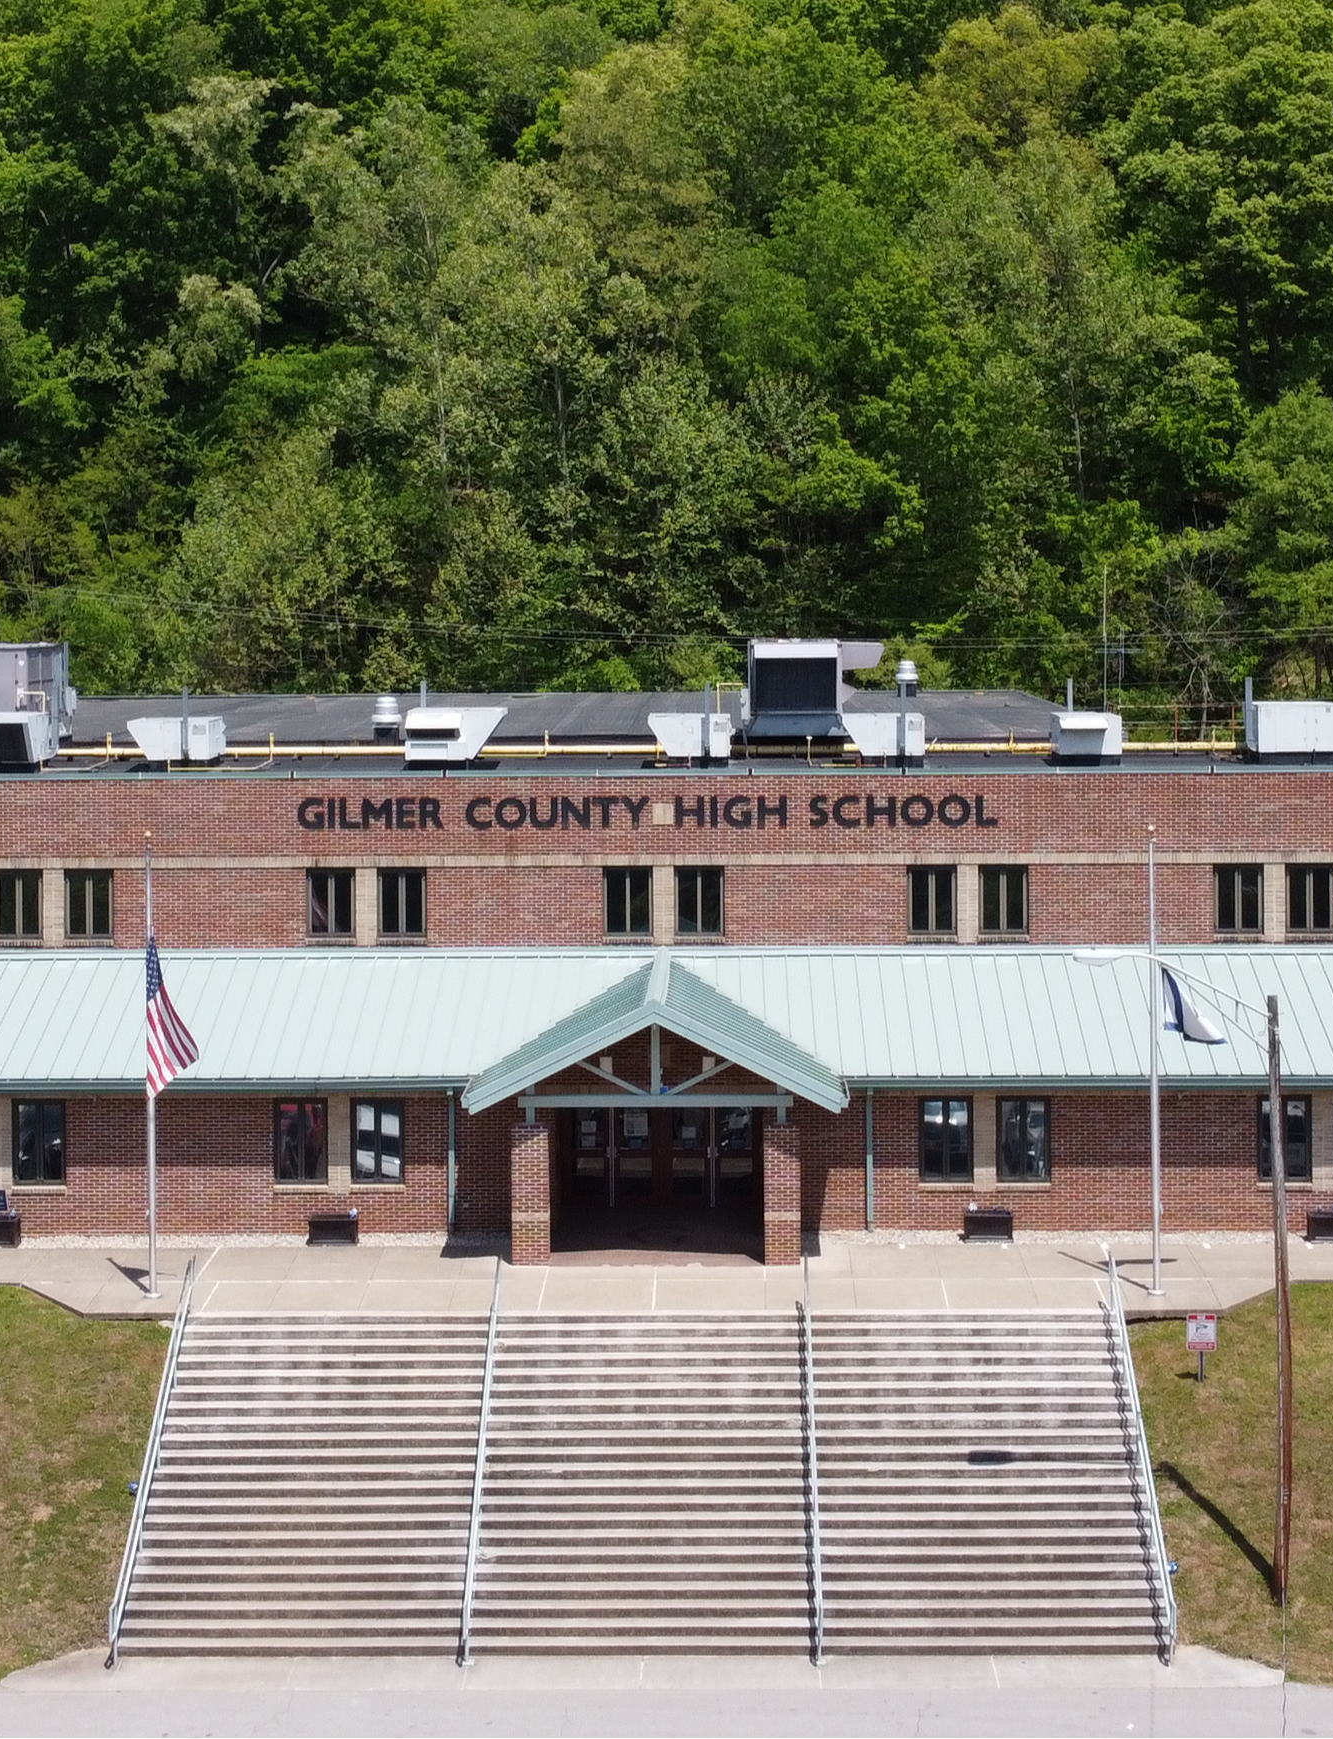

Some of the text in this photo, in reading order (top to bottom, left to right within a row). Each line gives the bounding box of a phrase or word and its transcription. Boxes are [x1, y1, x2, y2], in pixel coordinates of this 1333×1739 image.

[297, 793, 998, 831] GILMER COUNTY HIGH SCHOOL
